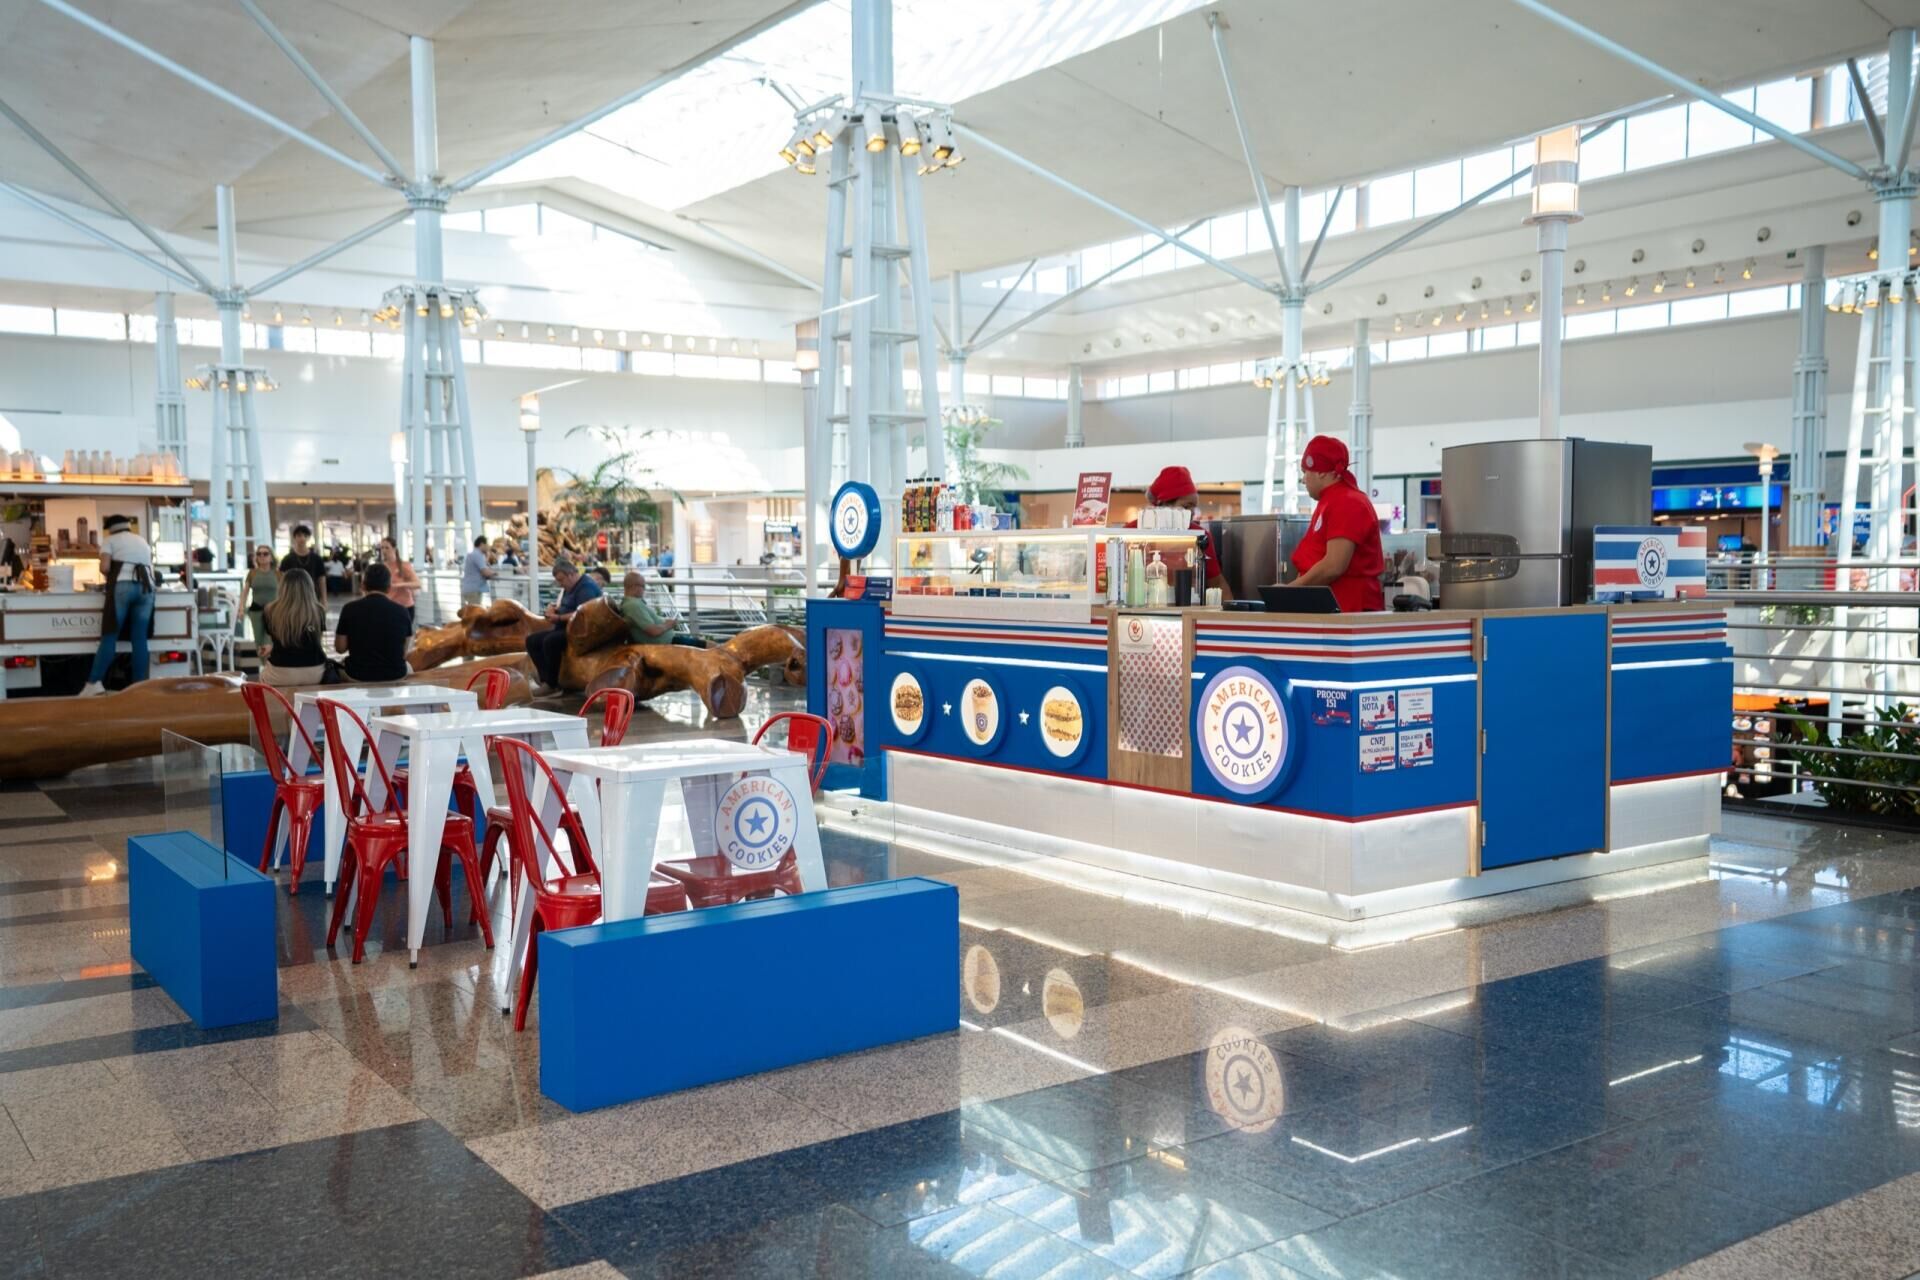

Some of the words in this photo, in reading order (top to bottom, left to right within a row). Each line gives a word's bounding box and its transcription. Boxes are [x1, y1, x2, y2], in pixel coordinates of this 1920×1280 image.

[1640, 540, 1666, 559] AMERICAN
[1641, 569, 1664, 586] COOKIES
[51, 616, 96, 627] BACIO
[1210, 681, 1278, 725] AMERICAN
[1316, 689, 1347, 701] PROCON
[1361, 702, 1379, 711] NOTA
[1370, 736, 1386, 747] CNPJ
[1215, 744, 1272, 777] COOKIES
[721, 780, 792, 817] AMERICAN
[728, 834, 788, 865] COOKIES
